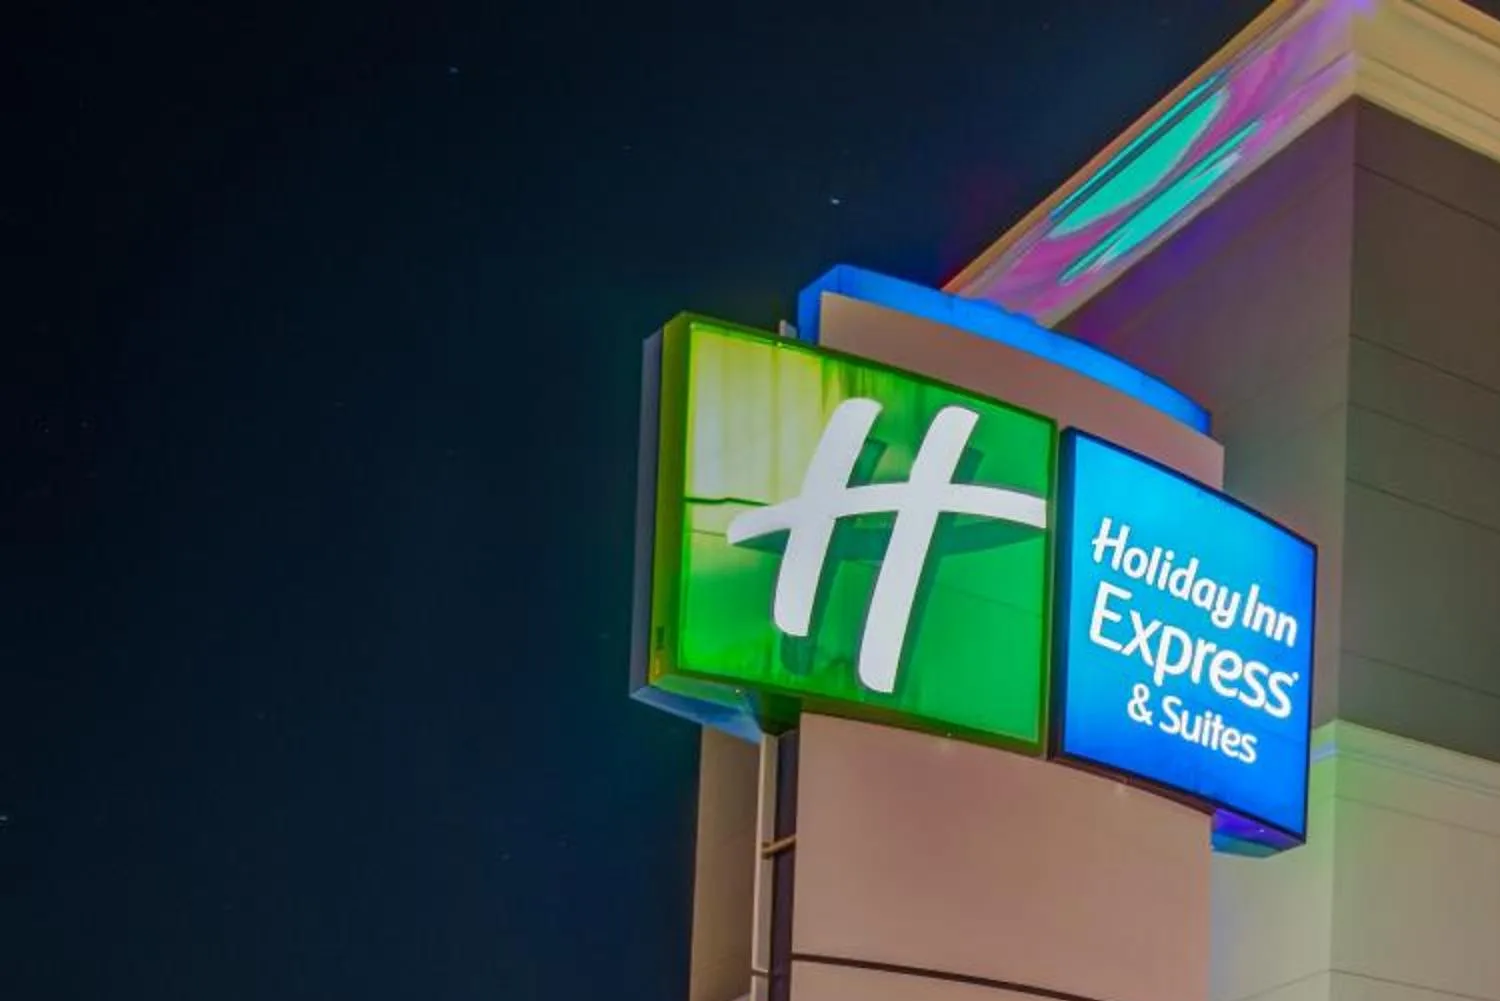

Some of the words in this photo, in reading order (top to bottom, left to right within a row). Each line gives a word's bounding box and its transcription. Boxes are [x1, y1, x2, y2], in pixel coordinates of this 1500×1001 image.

[727, 398, 1047, 693] H
[1092, 517, 1240, 629] Holiday
[1243, 585, 1298, 646] Inn
[1090, 581, 1295, 718] Express
[1127, 683, 1153, 725] &
[1159, 695, 1258, 764] Suites
